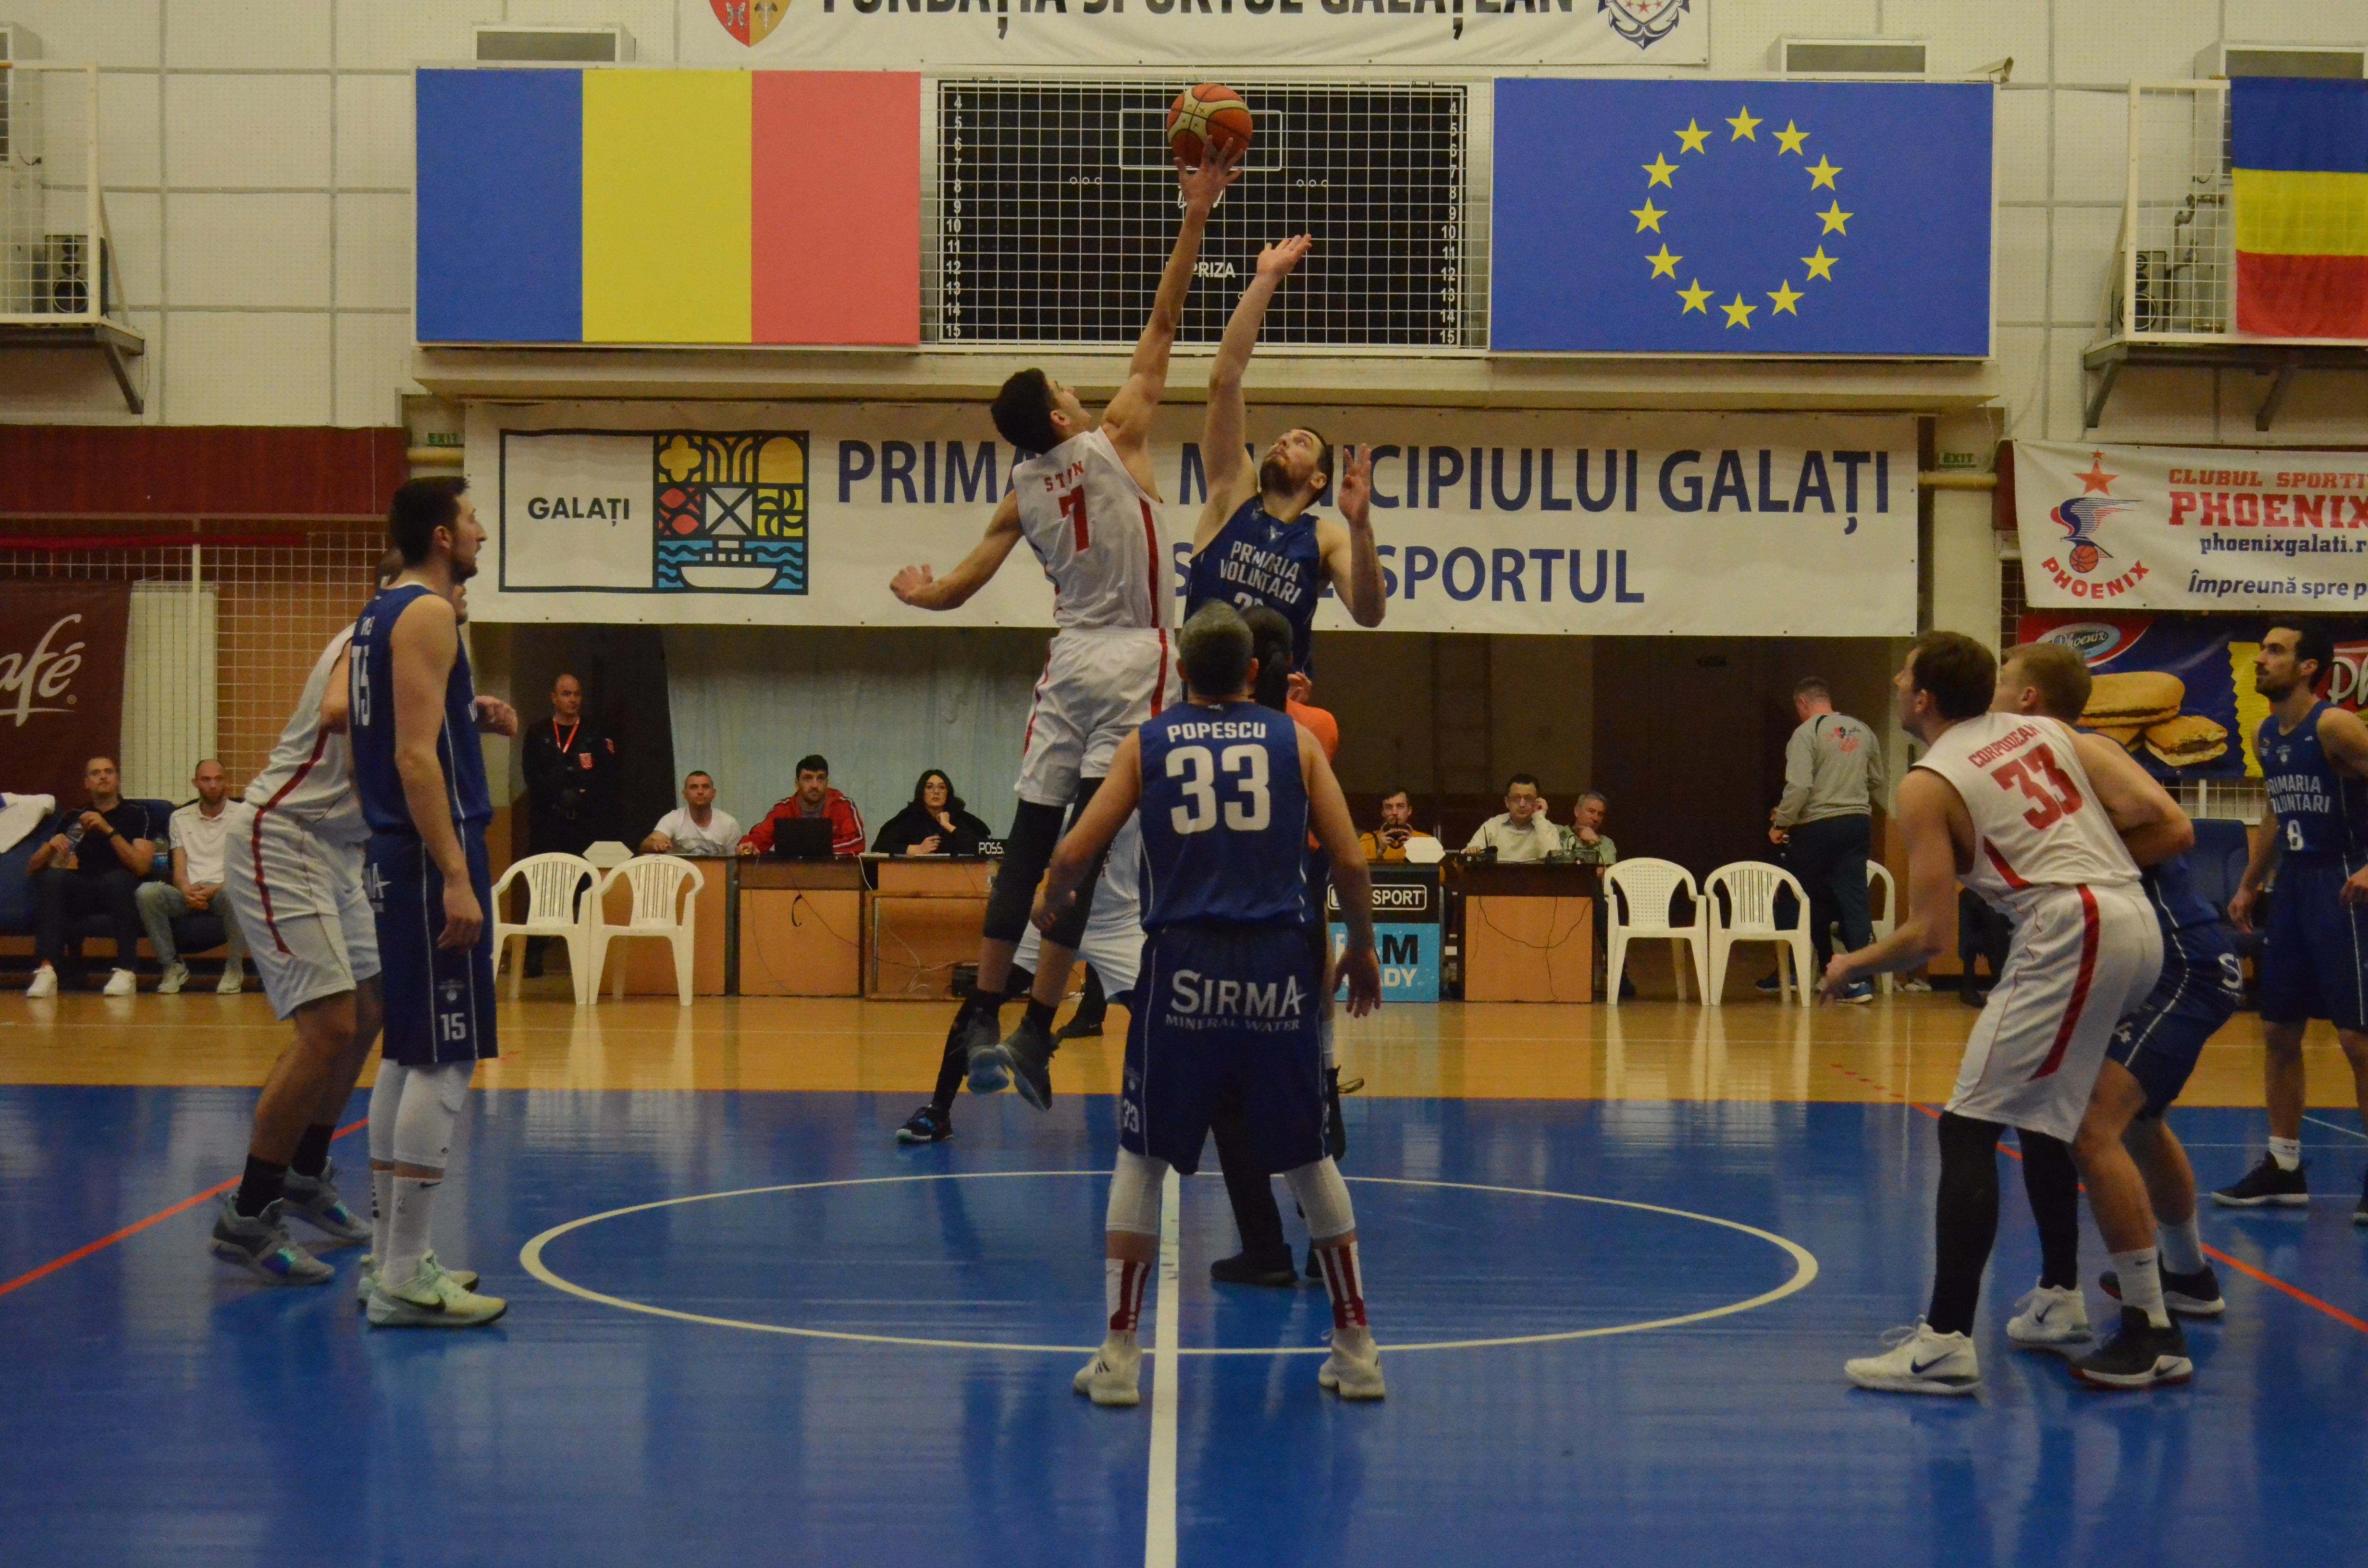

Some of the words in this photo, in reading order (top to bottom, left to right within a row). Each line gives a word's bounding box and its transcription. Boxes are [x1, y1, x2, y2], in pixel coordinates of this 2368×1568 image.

[954, 95, 962, 109] 4
[1450, 101, 1457, 115] 4
[955, 116, 962, 129] 5
[1450, 122, 1457, 136] 5
[955, 137, 962, 151] 6
[1450, 143, 1457, 157] 6
[955, 158, 962, 173] 7
[1450, 165, 1457, 178] 7
[954, 179, 962, 192] 8
[1450, 185, 1456, 199] 8
[954, 199, 962, 213] 9
[1449, 206, 1456, 220] 9
[947, 219, 962, 233] 10
[1442, 225, 1456, 239] 10
[948, 240, 960, 253] 11
[1443, 246, 1455, 260] 11
[946, 260, 961, 274] 12
[1441, 267, 1455, 281] 12
[946, 281, 961, 295] 13
[1441, 288, 1455, 302] 13
[946, 302, 961, 316] 14
[1440, 309, 1455, 323] 14
[946, 323, 961, 337] 15
[1440, 330, 1455, 343] 15
[2168, 468, 2263, 488] CLUBUL
[2276, 472, 2368, 489] SPORTI
[839, 439, 1033, 503] PRIM
[1658, 449, 1888, 535] GALAȚI
[528, 497, 629, 527] GALAȚI
[1058, 484, 1090, 552] 7
[2199, 532, 2368, 557] phoenixgalati.r
[1230, 540, 1300, 582] PRMARIA
[2041, 556, 2150, 600] PHOENIX
[2188, 569, 2297, 598] Împreună
[2301, 582, 2349, 600] spre
[1166, 722, 1267, 743] POPESCU
[1968, 724, 2042, 769] CORPODEAN
[1165, 744, 1271, 835] 33
[1990, 742, 2083, 831] 33
[2287, 819, 2304, 851] 8
[979, 842, 1005, 855] POSS.
[1171, 969, 1308, 1017] SIRMA
[440, 1013, 467, 1041] 15
[1165, 1014, 1239, 1030] MINERAL
[1246, 1017, 1300, 1032] WATER
